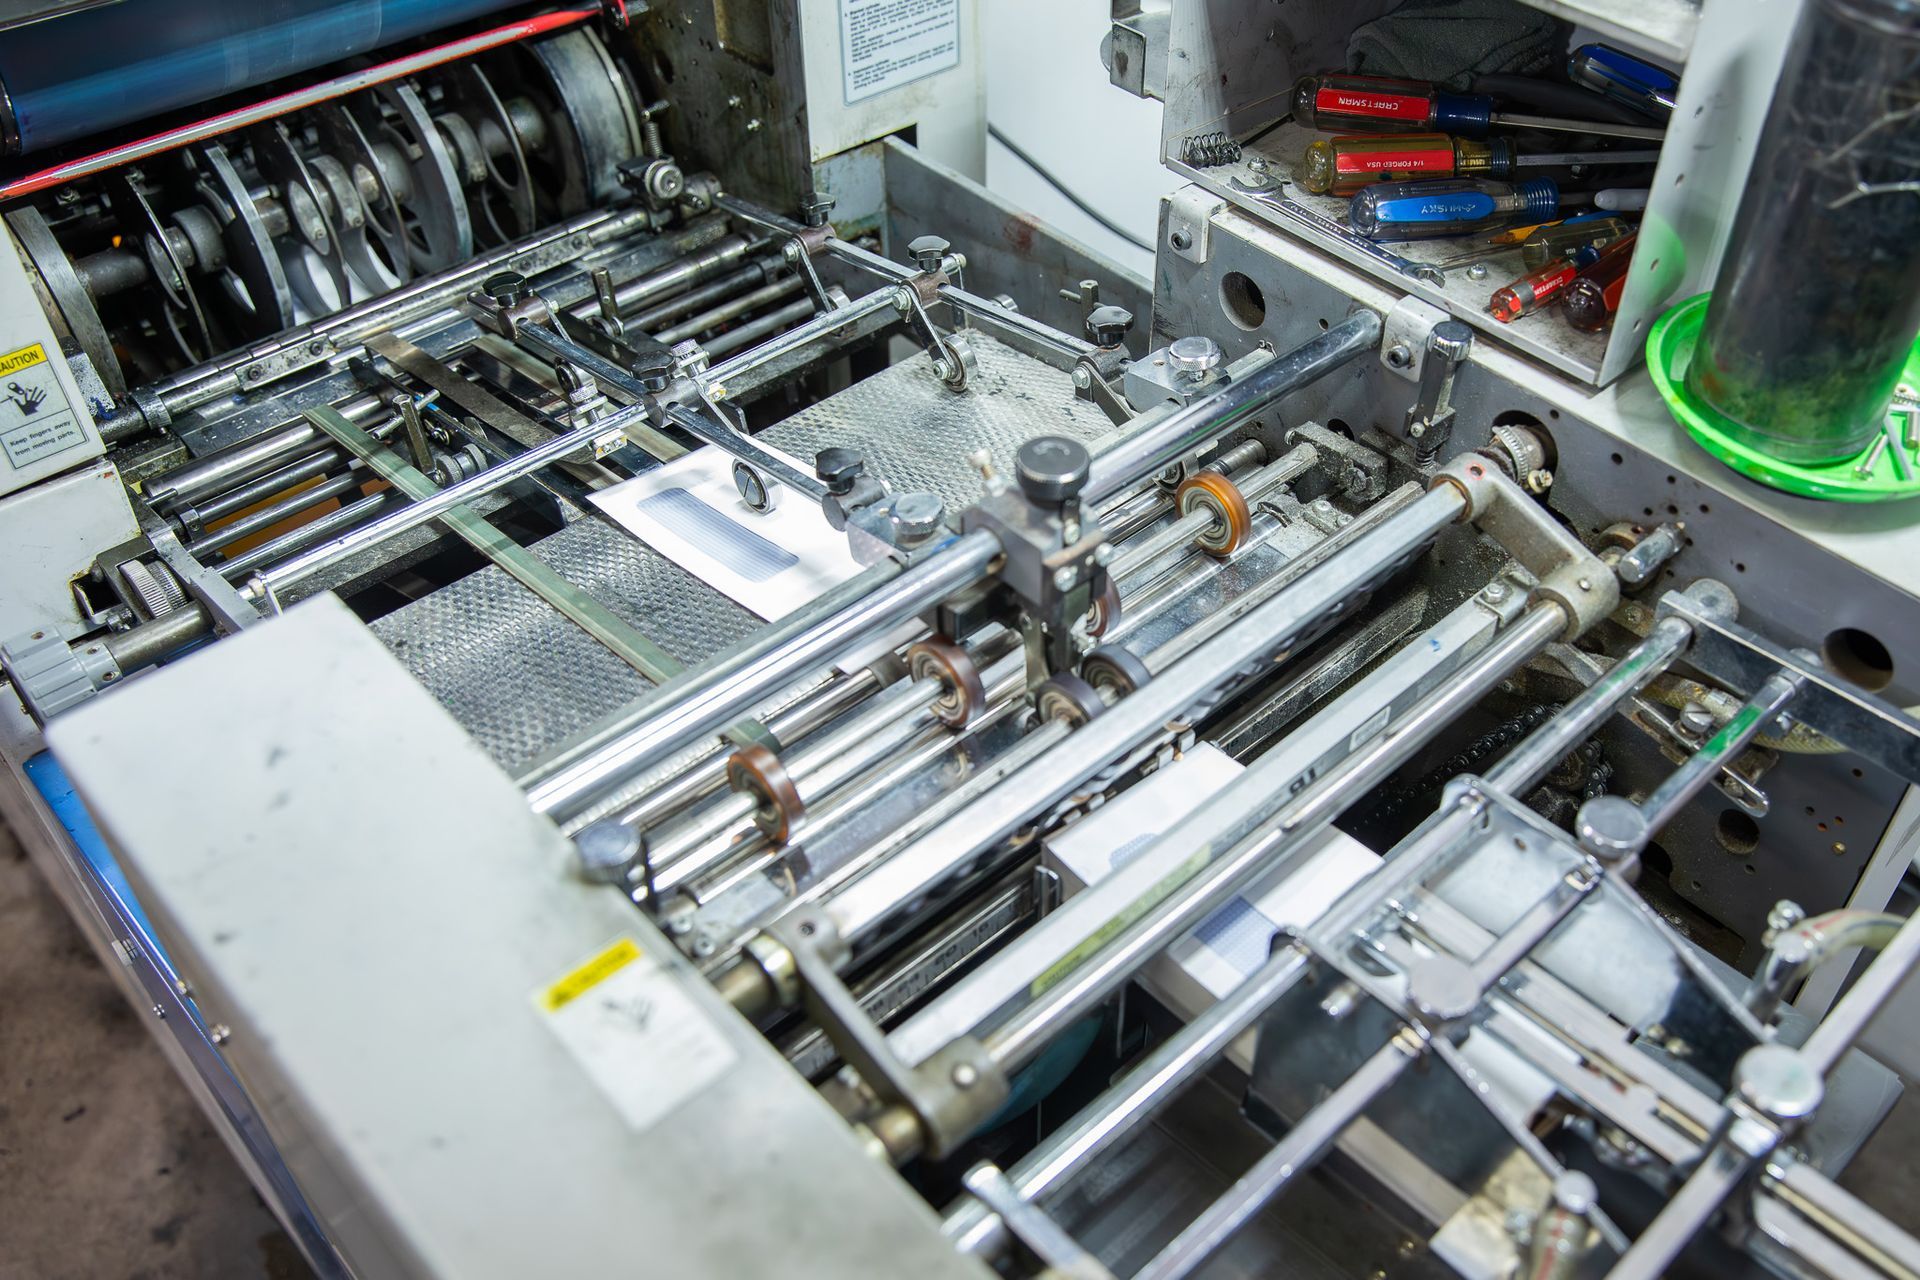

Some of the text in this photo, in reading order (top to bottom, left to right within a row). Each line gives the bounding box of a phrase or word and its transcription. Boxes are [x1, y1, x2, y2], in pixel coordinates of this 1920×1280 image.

[1338, 96, 1399, 110] CRAFTSMAN
[1382, 160, 1411, 168] FORGED
[0, 350, 39, 372] AUTION
[10, 421, 71, 446] Keep fingers away
[15, 447, 30, 456] from
[32, 437, 56, 449] moving
